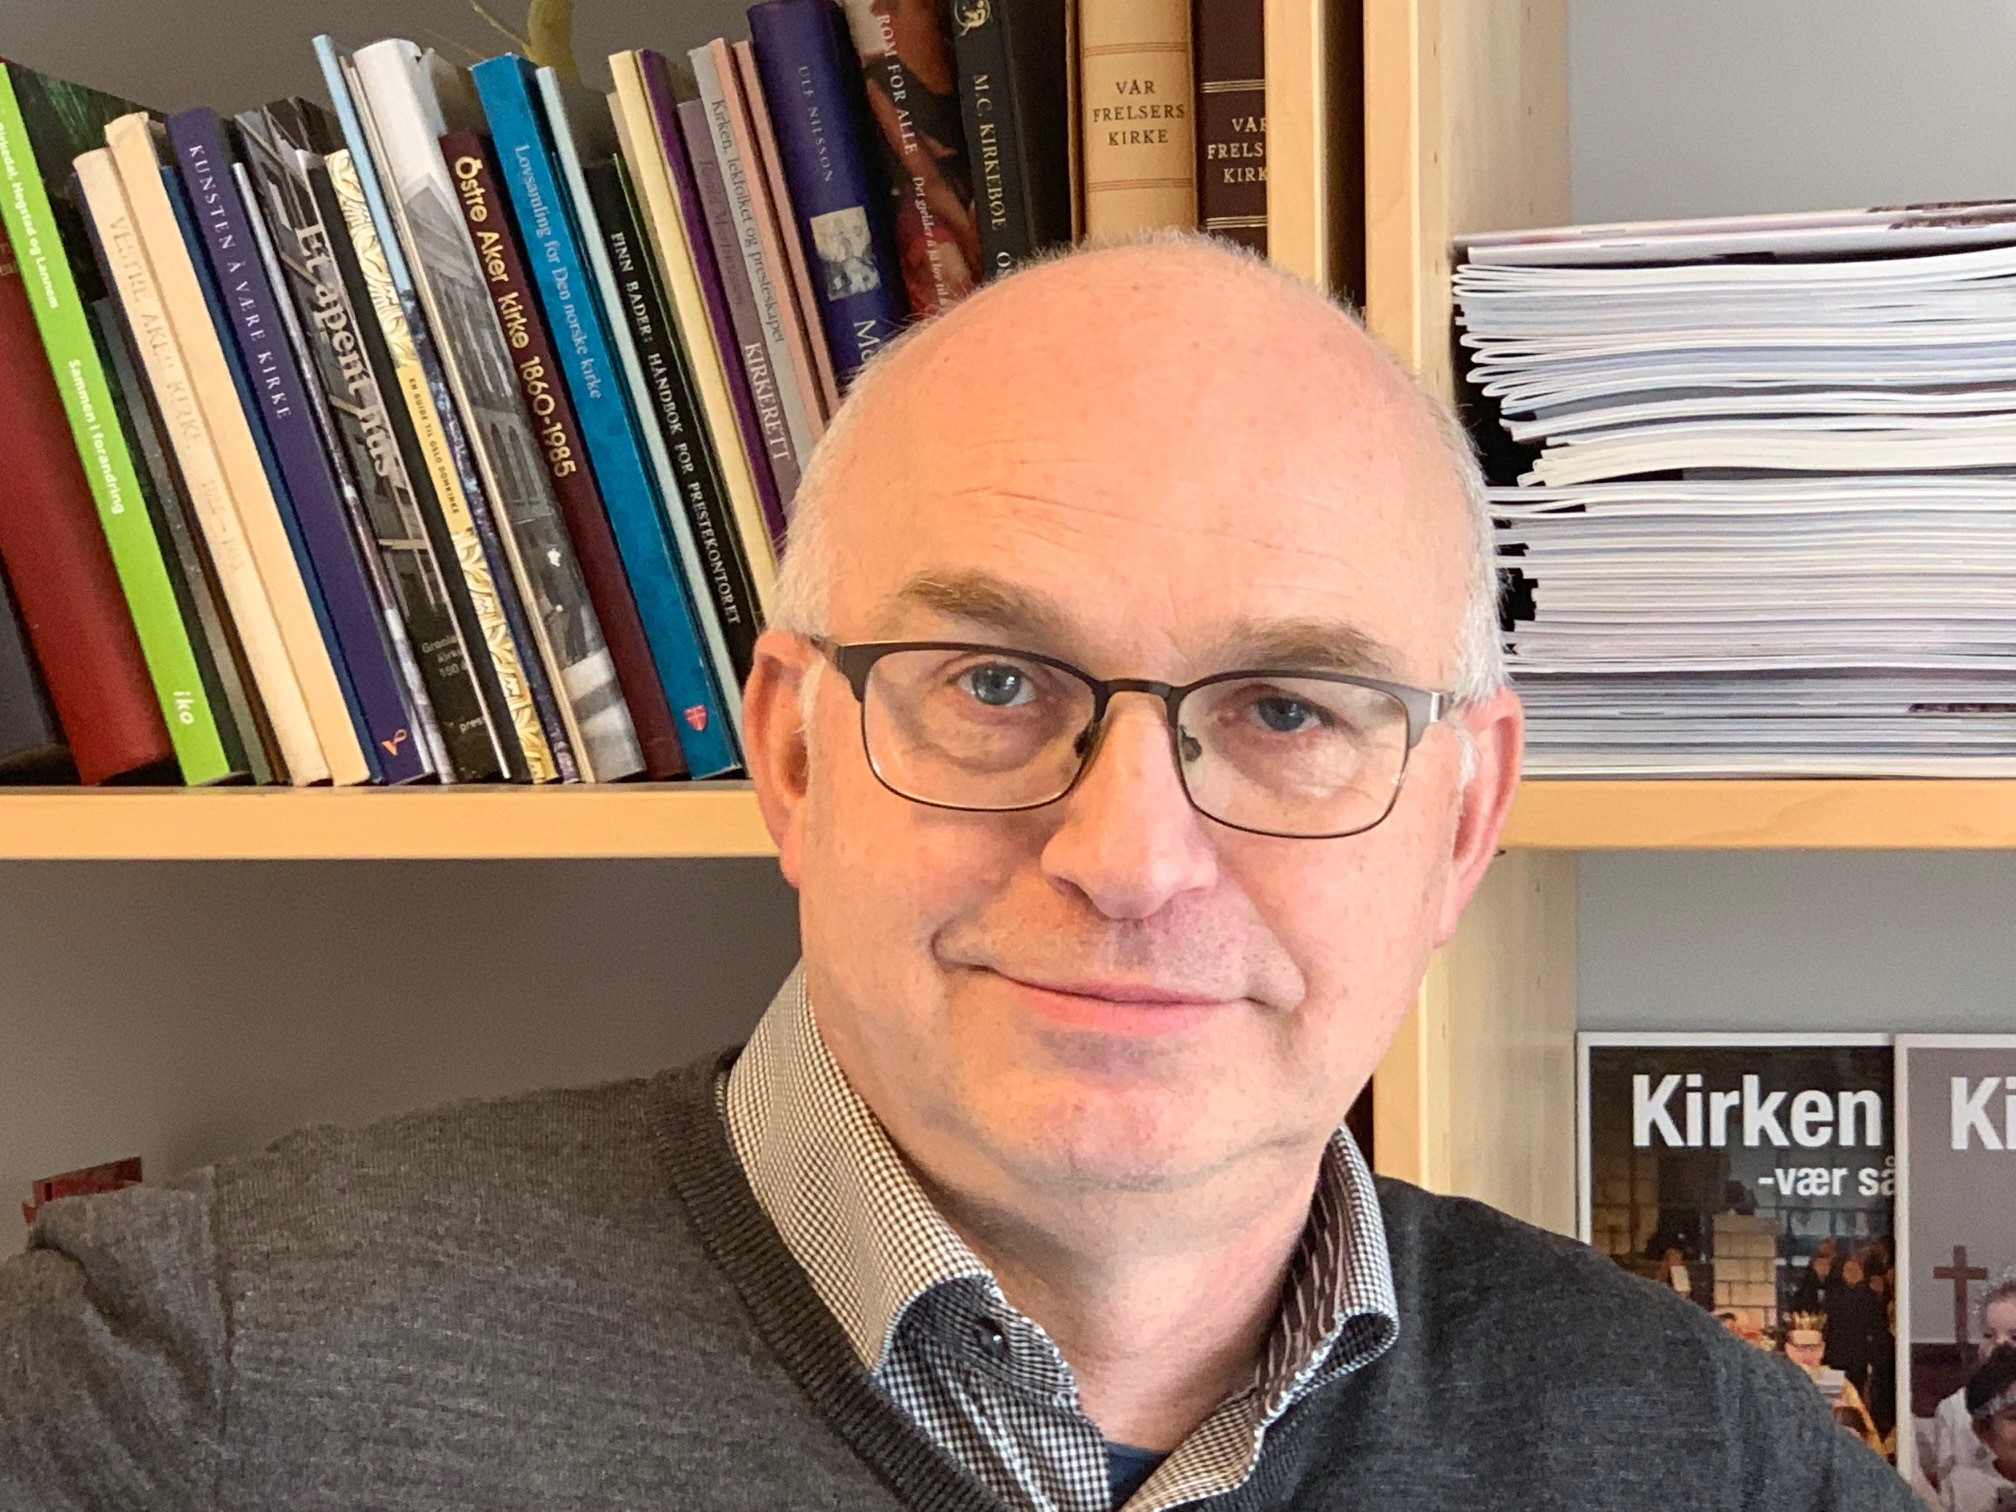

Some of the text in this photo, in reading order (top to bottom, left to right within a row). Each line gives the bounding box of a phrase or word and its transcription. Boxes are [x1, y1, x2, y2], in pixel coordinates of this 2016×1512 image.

[879, 14, 919, 156] ROM FOR ALLE
[1093, 103, 1185, 123] FRELSERS
[808, 106, 833, 182] NILSSON
[1108, 129, 1168, 146] KIRKE
[12, 181, 37, 236] Hegstad
[29, 237, 41, 256] og
[295, 224, 329, 274] Et
[744, 226, 759, 248] og
[189, 145, 292, 420] KUNSTEN Å VÆRE KIRKE
[514, 144, 602, 400] Lovsamling for Den norske kirke
[476, 231, 509, 284] Aker
[498, 292, 530, 350] kirke
[520, 356, 577, 479] 1860-1985
[68, 359, 96, 423] Sammen
[92, 432, 125, 514] forandring
[610, 231, 634, 273] FINN
[648, 352, 683, 435] HÅNDBOK
[674, 442, 695, 475] FOR
[687, 481, 741, 625] PRESTEKONTORET
[745, 342, 791, 462] KIRKERETT
[414, 393, 428, 421] GUIDE
[424, 423, 434, 438] TIL
[429, 440, 443, 464] OSLO
[438, 466, 459, 514] DOMKIRKE
[173, 691, 195, 725] iko
[1632, 1073, 1883, 1148] Kirken
[1950, 1075, 2016, 1150] Ki
[1757, 1166, 1848, 1197] -vær
